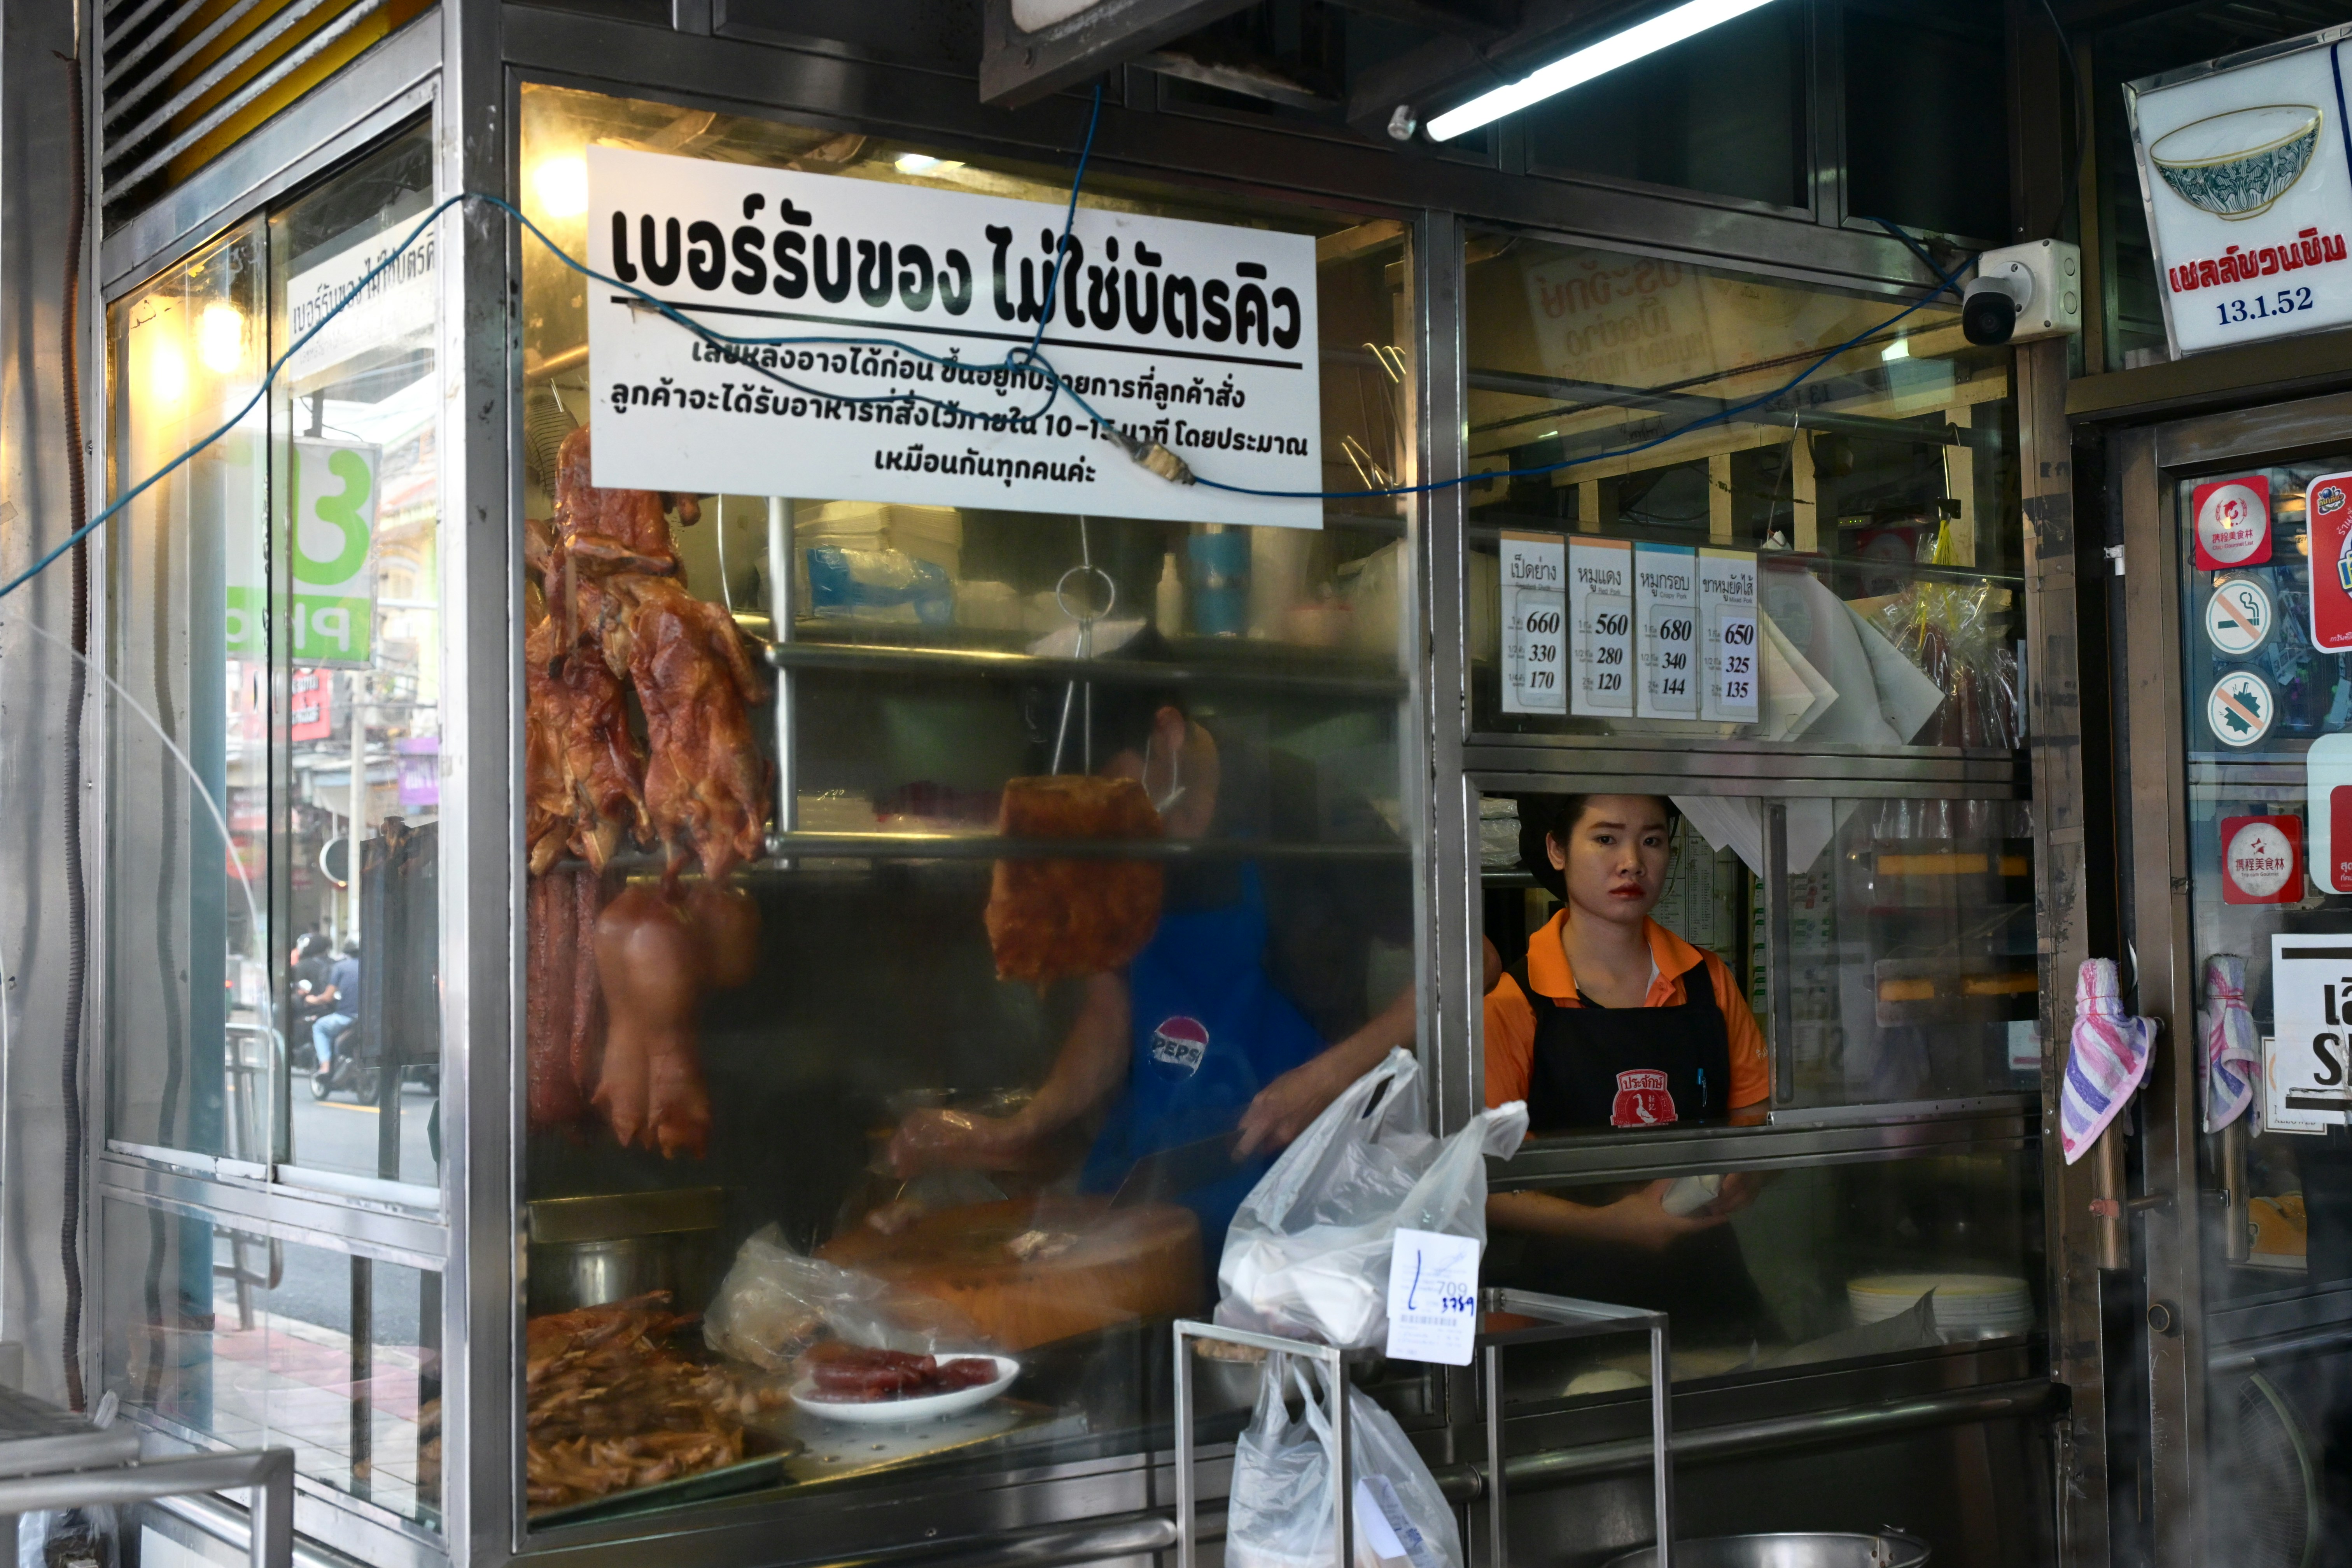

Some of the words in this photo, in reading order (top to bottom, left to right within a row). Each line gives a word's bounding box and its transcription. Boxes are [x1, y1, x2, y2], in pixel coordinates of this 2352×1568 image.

[2169, 228, 2347, 293] เชลล์ชวนชิม
[612, 193, 972, 315] เบอร์รับของ
[985, 223, 1301, 350] ไม่ใช่บัตรคิว
[2217, 287, 2313, 326] 13.1.52
[1175, 420, 1308, 456] โดยประมาณ
[874, 443, 1097, 486] เหมือนกันทุกคนค่ะ
[2212, 528, 2253, 544] 携程美食林
[1511, 553, 1557, 581] เป็ดย่าง
[1578, 568, 1621, 592] หมูแดง
[1640, 572, 1690, 597] หมูกรอบ
[1526, 611, 1560, 634] 660
[1595, 613, 1628, 636] 560
[1660, 619, 1692, 641] 680
[1725, 623, 1754, 646] 650
[1529, 644, 1556, 662] 330
[1596, 647, 1623, 665] 280
[1662, 652, 1687, 670] 340
[1726, 656, 1750, 674] 325
[1530, 671, 1554, 689] 170
[1598, 673, 1622, 691] 120
[1662, 678, 1685, 695] 144
[1726, 681, 1749, 698] 135
[2235, 857, 2285, 871] 携程美食林
[1623, 1074, 1663, 1089] ประจักษ์
[1437, 1281, 1468, 1297] 709
